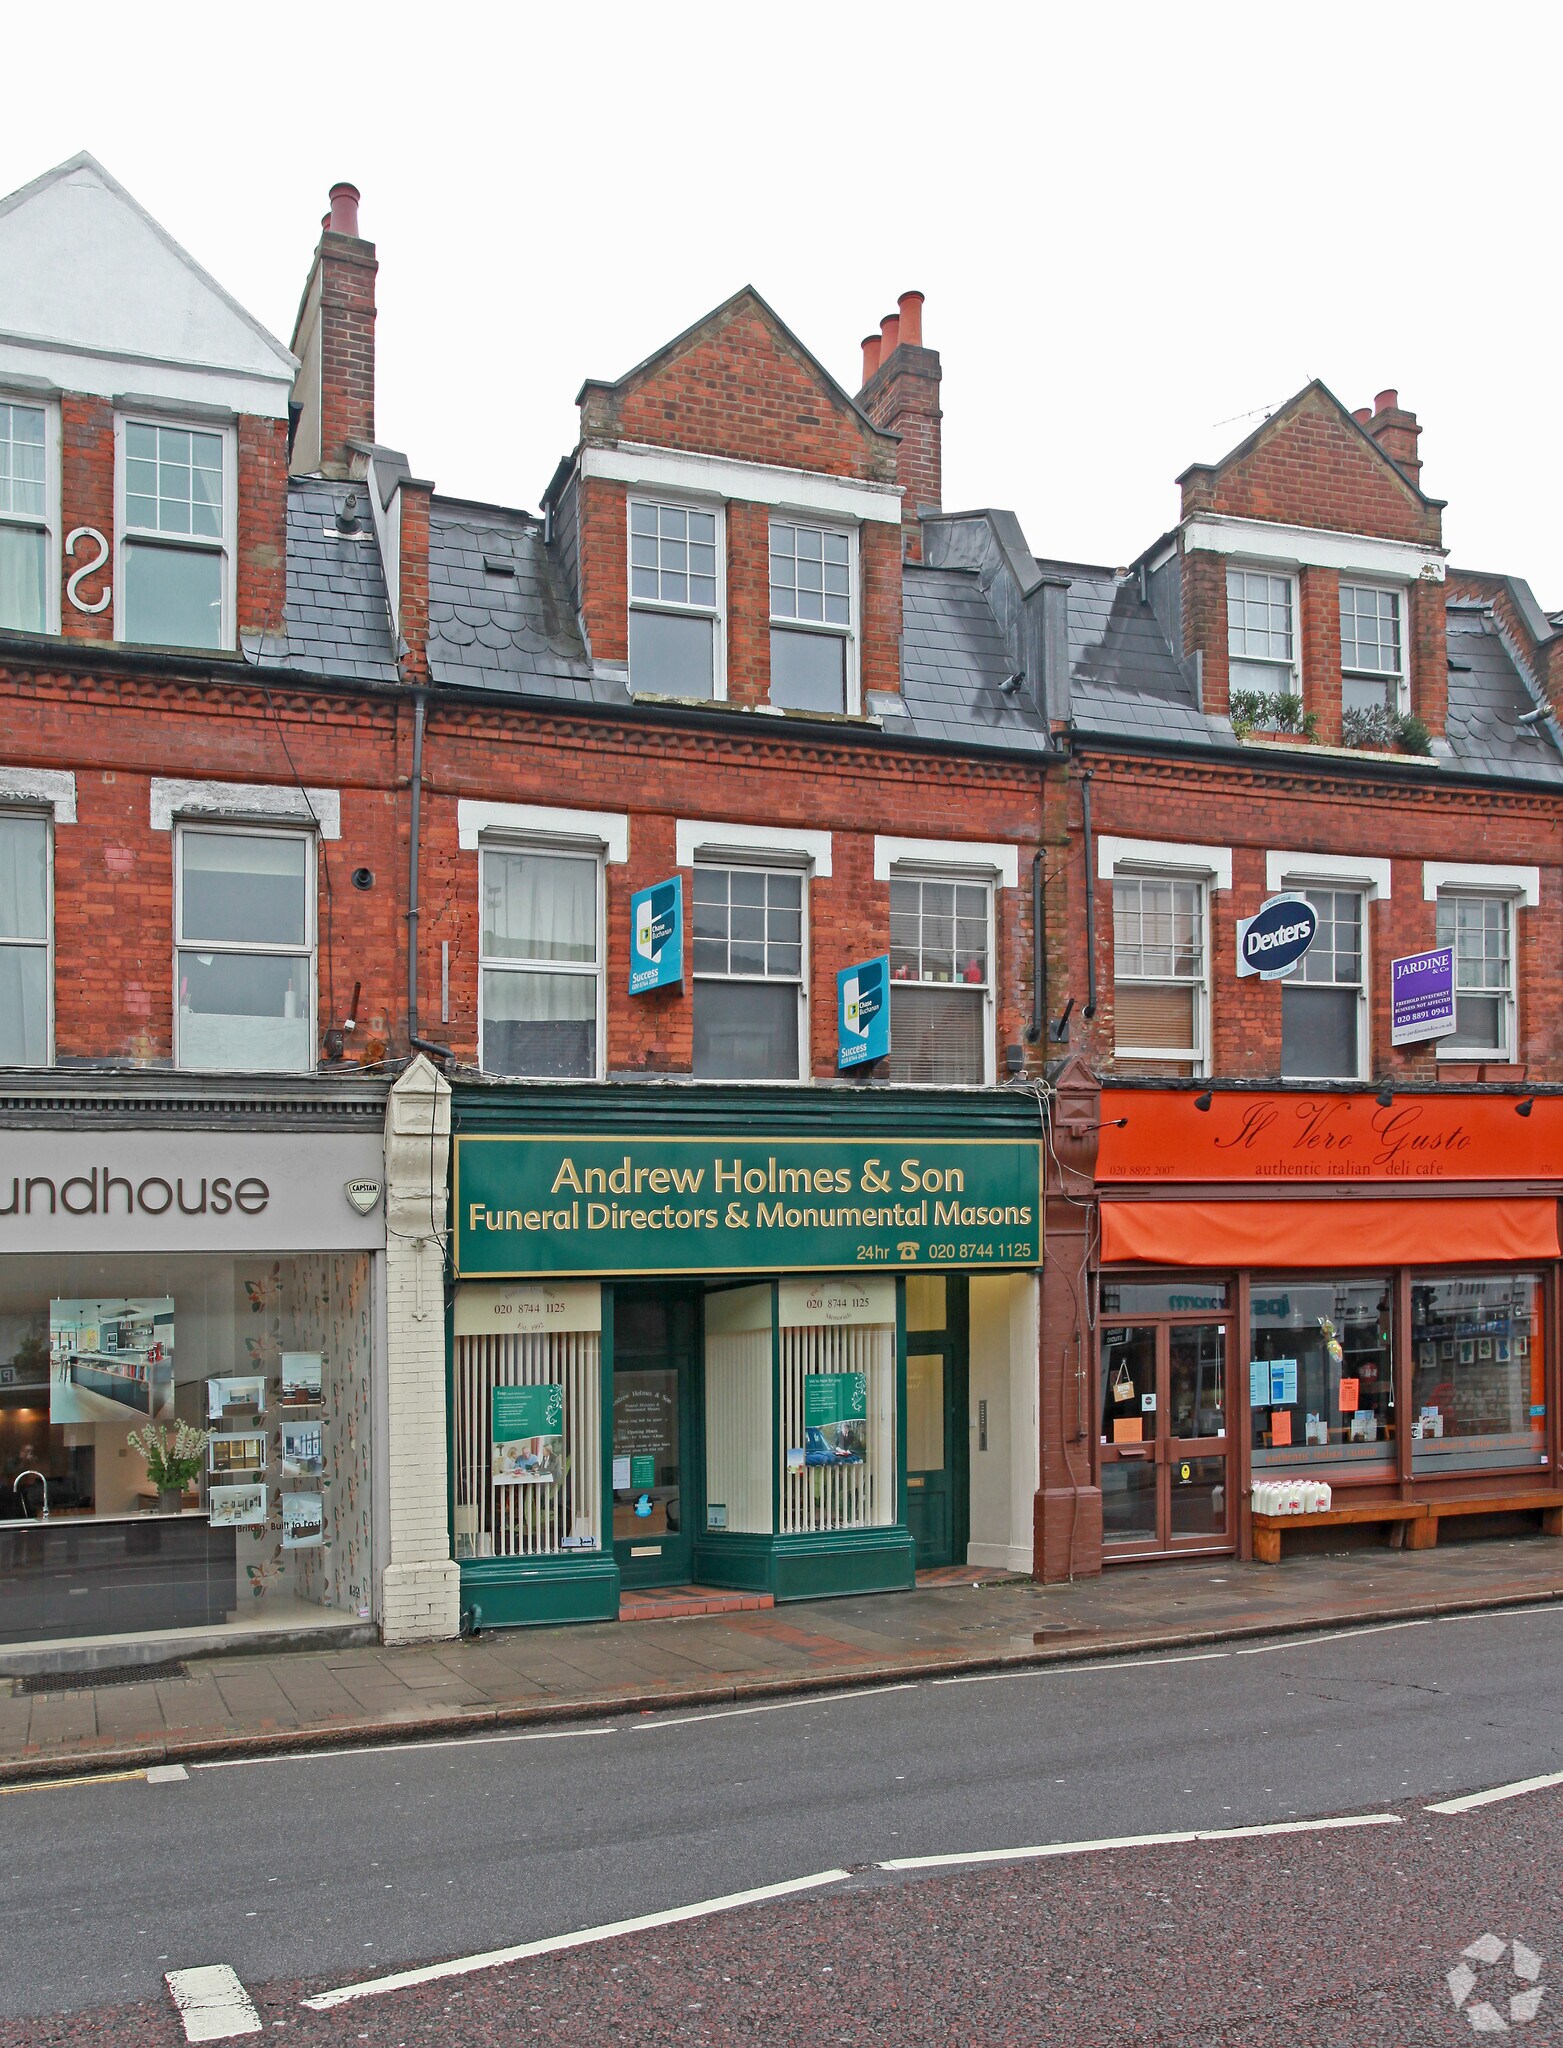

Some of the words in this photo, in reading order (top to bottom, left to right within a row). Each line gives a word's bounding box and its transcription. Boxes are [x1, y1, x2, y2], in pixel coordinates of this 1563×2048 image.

[652, 923, 665, 933] Chase
[652, 928, 673, 940] Buchanan
[1247, 920, 1311, 956] Dexters
[1396, 954, 1449, 980] JARDINE
[632, 968, 659, 984] Success
[860, 1000, 873, 1009] Chase
[1395, 1005, 1416, 1014] BUSINESS
[1427, 997, 1451, 1006] AFFECTED
[1396, 997, 1420, 1007] FREEHOLD
[1420, 990, 1450, 1001] INVESTMENT
[860, 1004, 880, 1016] Buchanan
[1397, 1014, 1411, 1024] 020
[1412, 1010, 1429, 1021] 8891
[1431, 1006, 1449, 1017] 0941
[841, 1043, 867, 1058] Success
[1214, 1101, 1279, 1149] Il
[1293, 1101, 1353, 1149] Vero
[1371, 1104, 1471, 1166] Gusto
[550, 1156, 705, 1194] Andrew
[714, 1157, 852, 1194] Holmes
[860, 1158, 892, 1193] &
[900, 1158, 965, 1193] Son
[1109, 1165, 1126, 1175] 020
[1129, 1165, 1151, 1175] 8892
[1154, 1165, 1175, 1175] 2007
[1255, 1159, 1320, 1175] authentic
[1327, 1160, 1370, 1175] italian
[1386, 1160, 1409, 1175] deli
[1416, 1160, 1443, 1175] cafe
[0, 1166, 270, 1215] undhouse
[352, 1184, 377, 1192] CAPSTAN
[469, 1201, 579, 1231] Funeral
[587, 1202, 719, 1230] Directors
[724, 1202, 751, 1229] &
[756, 1200, 927, 1228] Monumental
[933, 1200, 1032, 1227] Masons
[856, 1244, 890, 1260] 24hr
[929, 1244, 955, 1259] 020
[959, 1243, 994, 1258] 8744
[998, 1242, 1031, 1257] 1125
[494, 1304, 512, 1315] 020
[518, 1304, 540, 1314] 8744
[546, 1303, 565, 1313] 1125
[806, 1299, 823, 1309] 020
[827, 1299, 847, 1308] 8744
[852, 1298, 869, 1307] 1125
[662, 1394, 672, 1404] Son
[237, 1523, 268, 1533] Britain,
[271, 1521, 289, 1530] Built
[292, 1521, 301, 1529] to
